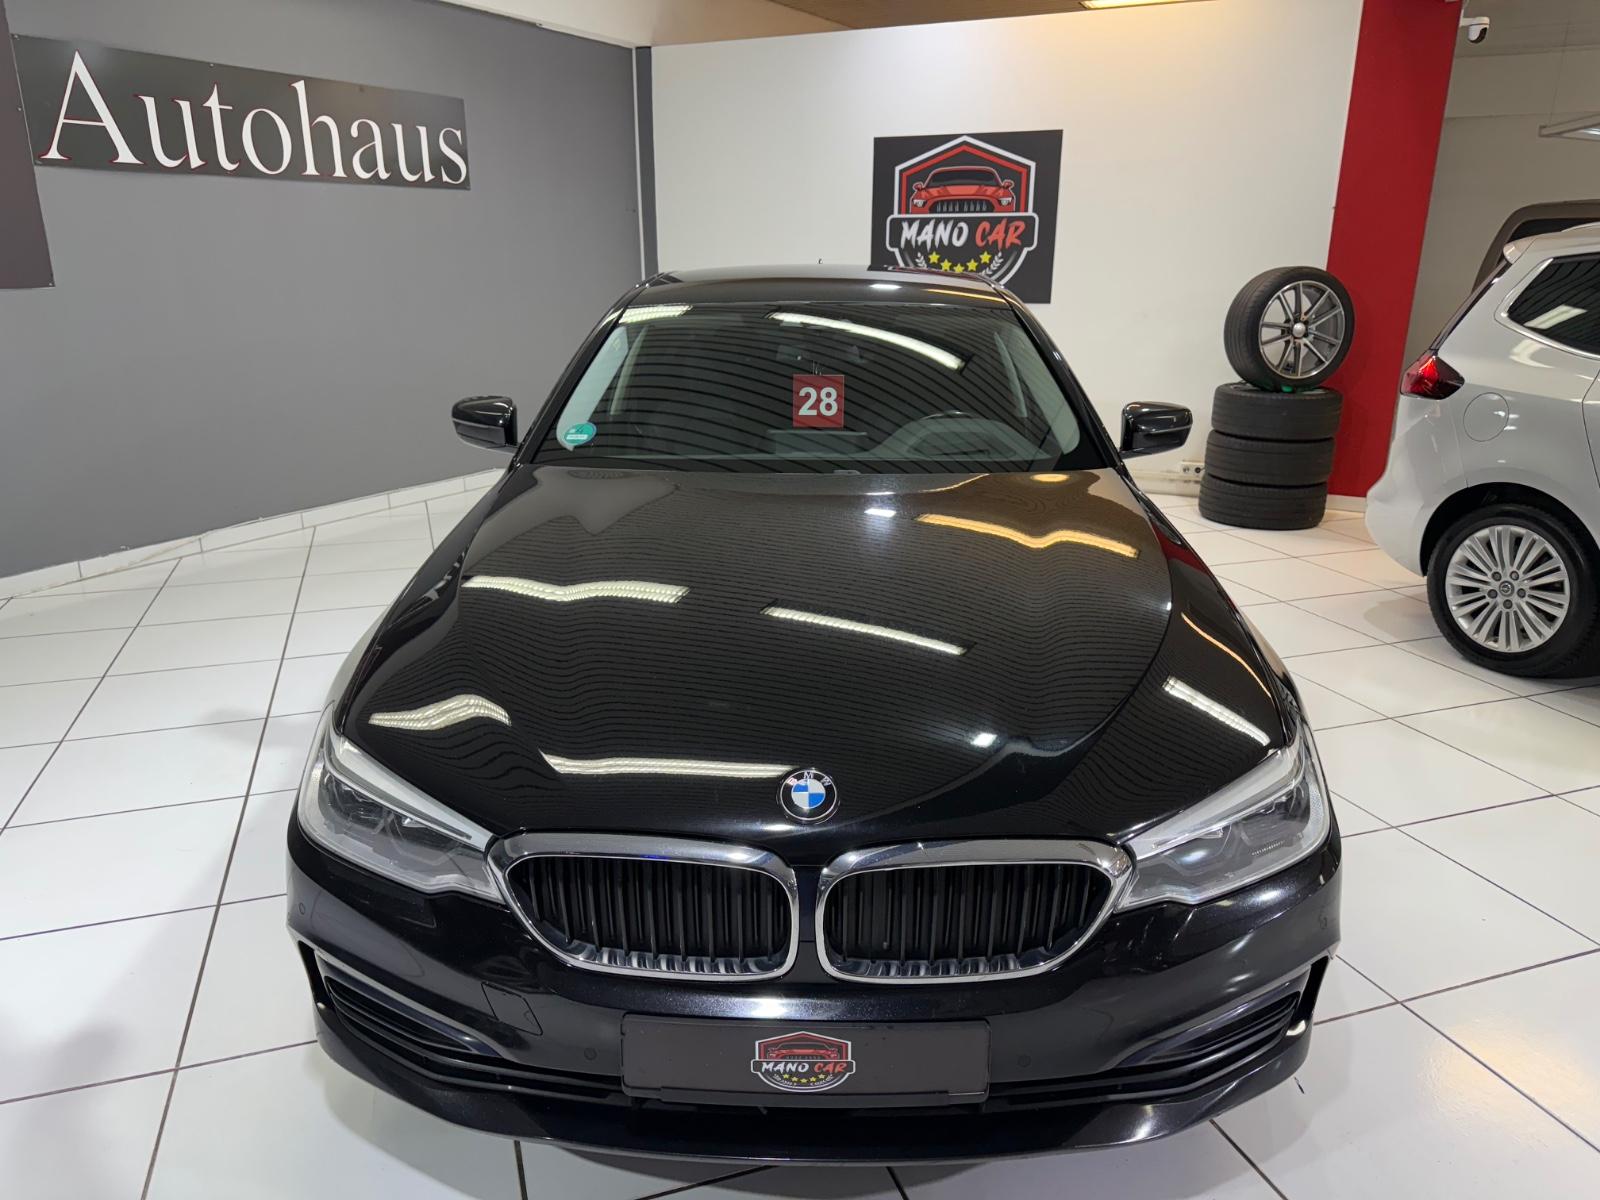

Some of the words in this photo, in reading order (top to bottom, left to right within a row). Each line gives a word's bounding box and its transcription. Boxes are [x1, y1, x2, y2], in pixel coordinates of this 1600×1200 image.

[39, 49, 467, 184] Autohaus
[900, 219, 969, 252] MANO
[975, 218, 1026, 249] CAR
[799, 386, 838, 416] 28
[761, 1061, 809, 1073] MANO
[814, 1062, 847, 1073] CAR
